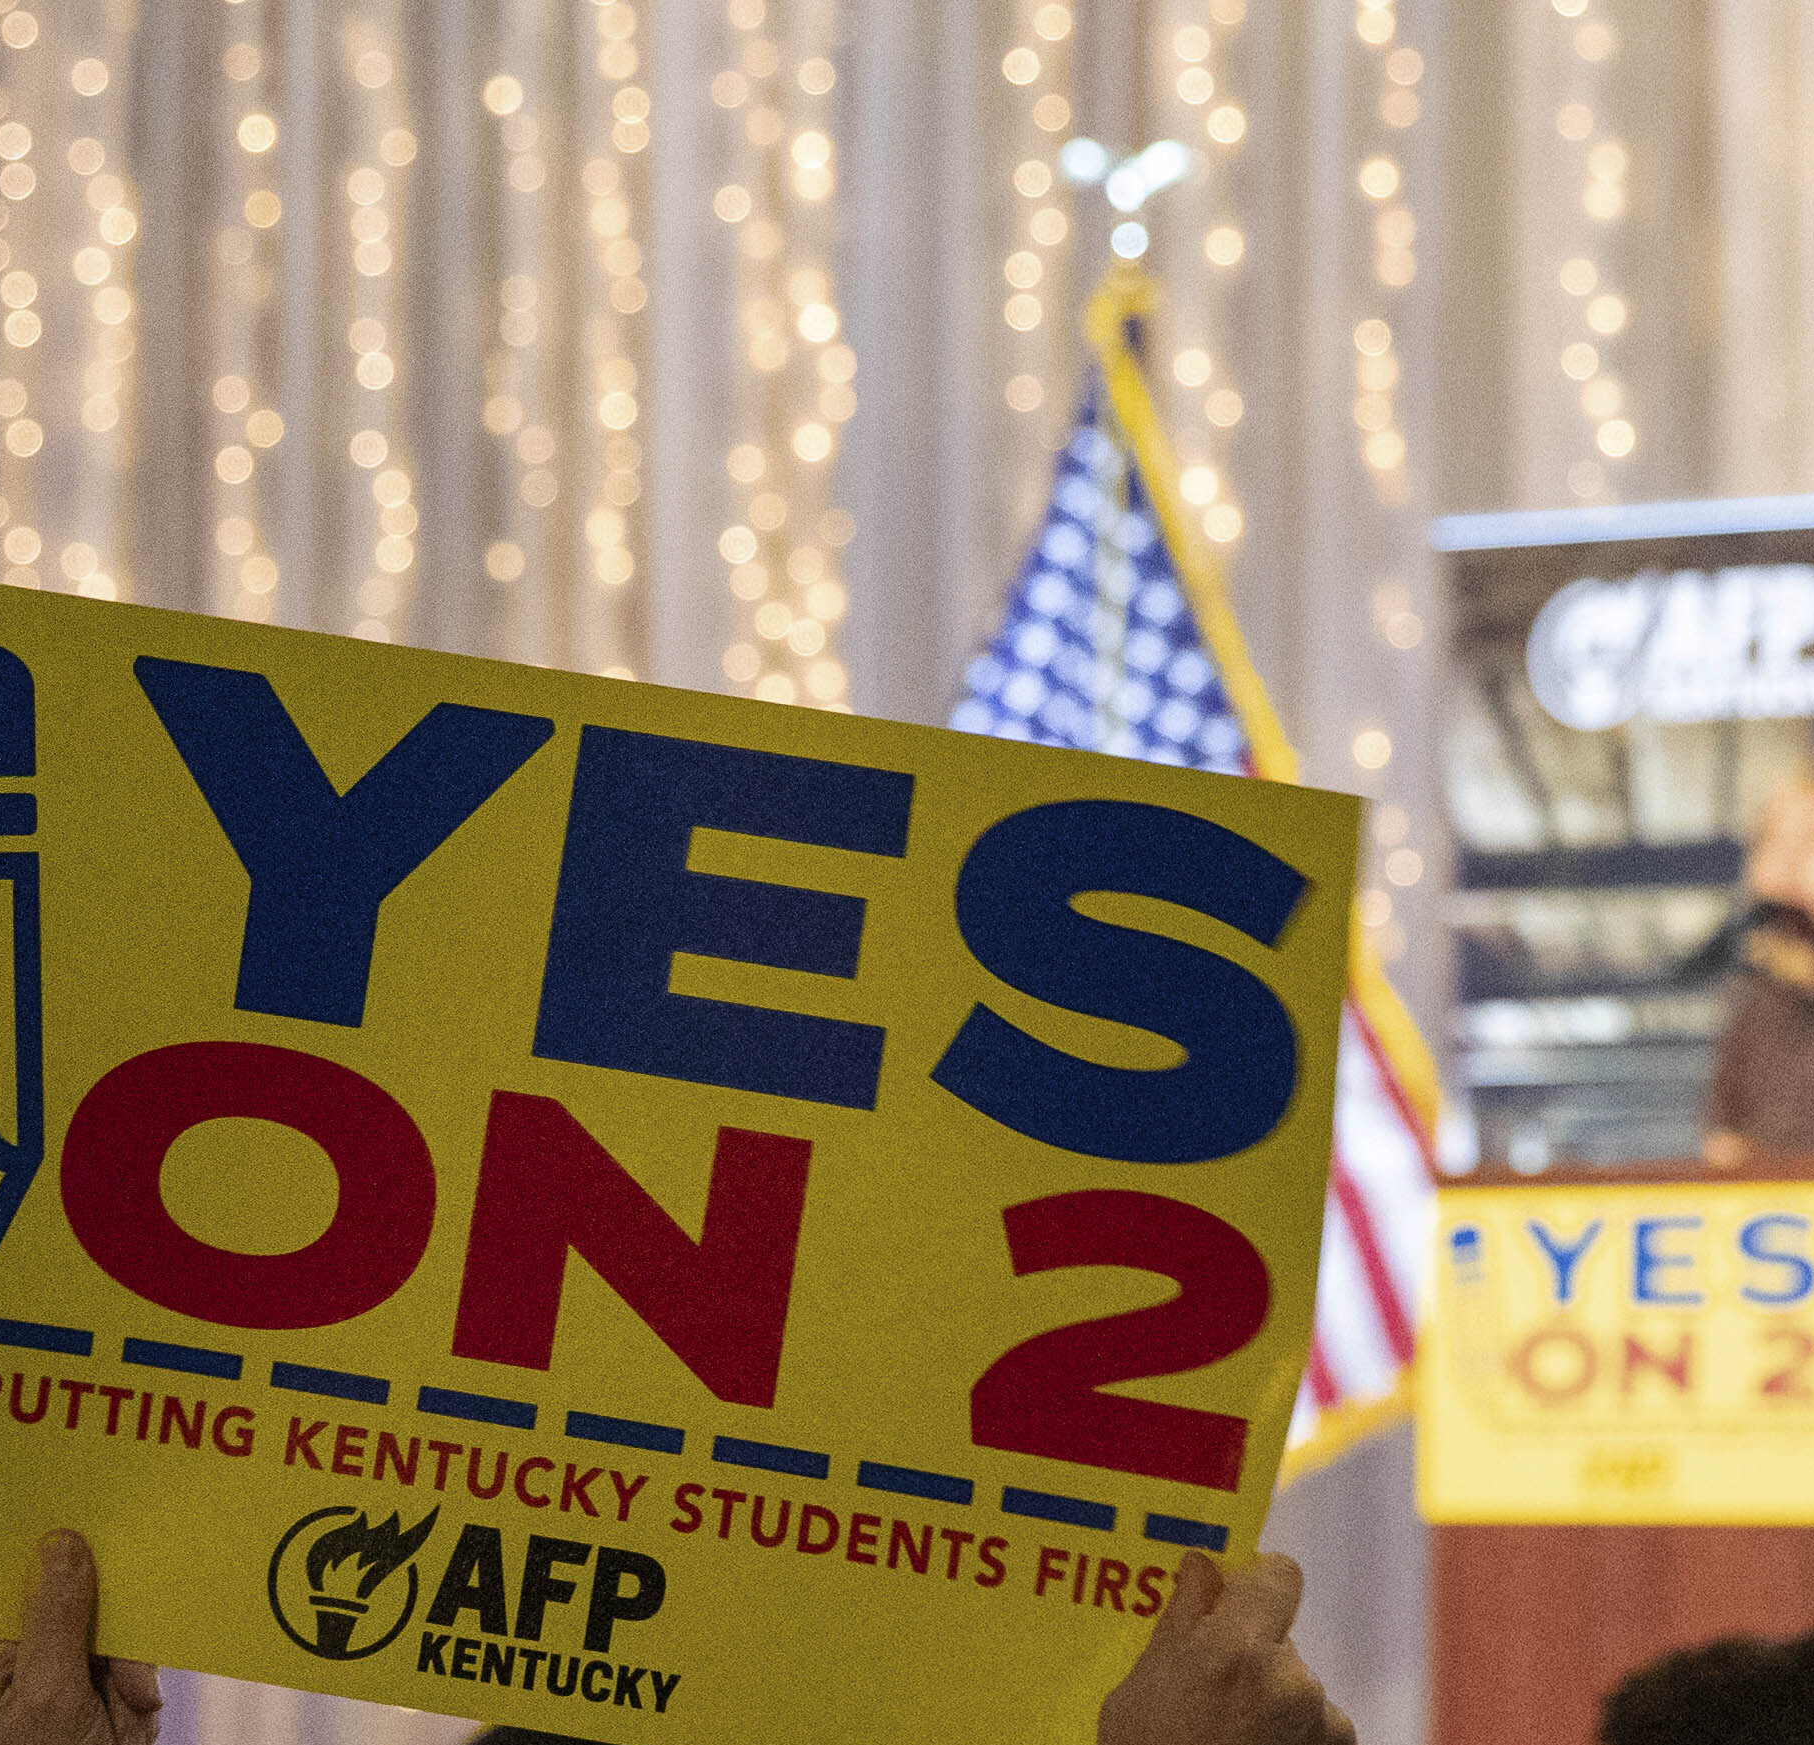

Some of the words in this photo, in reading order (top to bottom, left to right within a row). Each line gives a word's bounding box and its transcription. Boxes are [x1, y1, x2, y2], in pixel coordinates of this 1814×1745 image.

[133, 655, 1312, 1164] YES
[58, 1040, 814, 1409] ON
[969, 1188, 1273, 1493] 2
[1508, 1328, 1695, 1410] ON
[283, 1416, 649, 1523] KENTUCKY
[669, 1482, 1009, 1589] STUDENTS
[1035, 1546, 1177, 1618] FIRS
[425, 1522, 667, 1654] AFP
[415, 1631, 682, 1714] KENTUCKY
